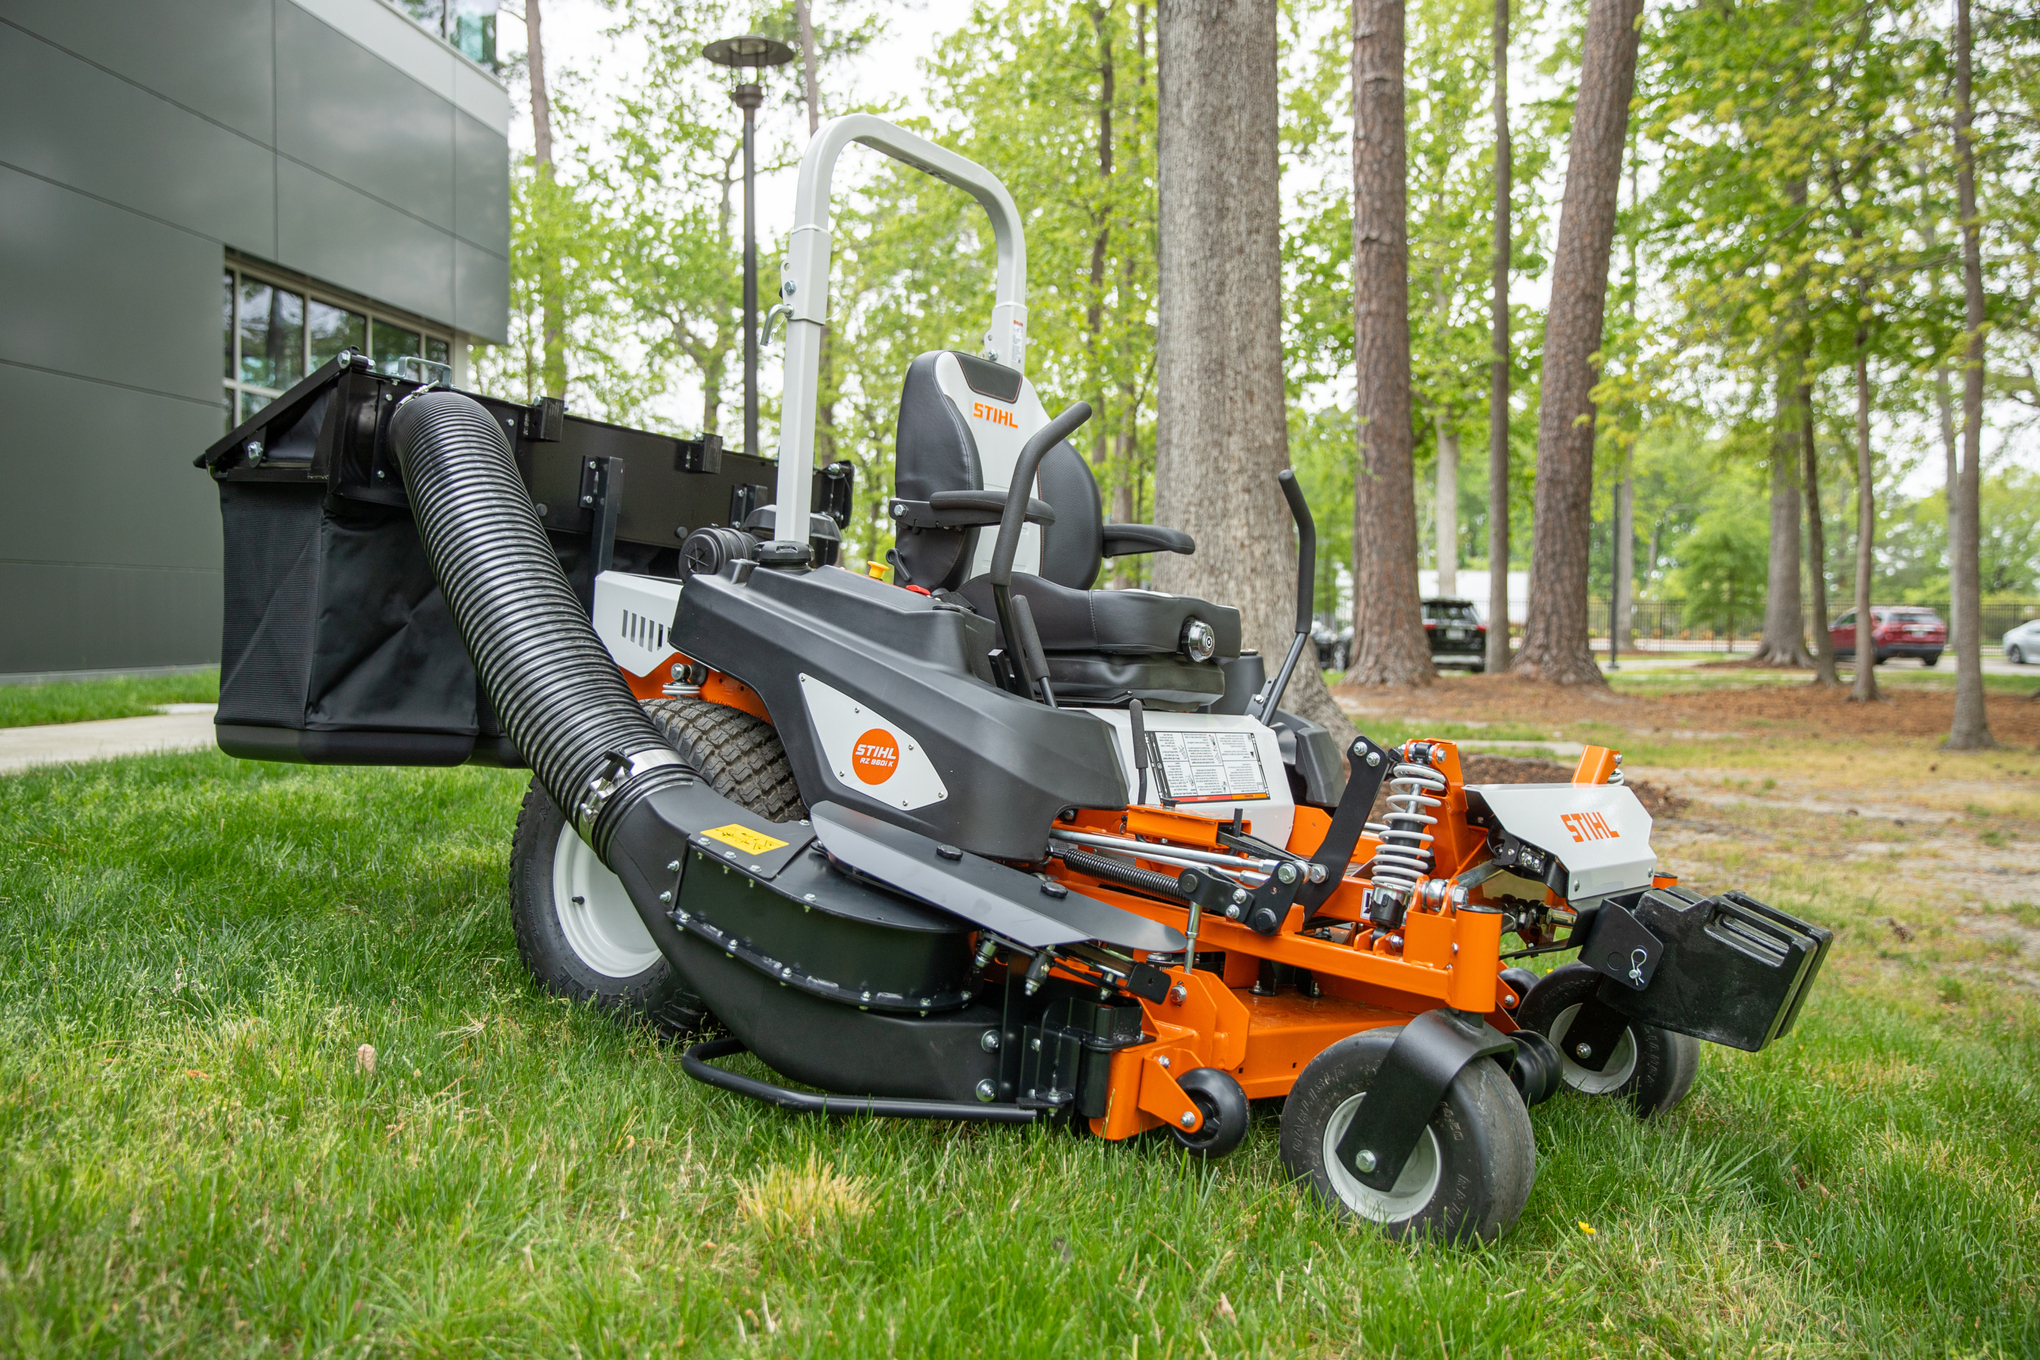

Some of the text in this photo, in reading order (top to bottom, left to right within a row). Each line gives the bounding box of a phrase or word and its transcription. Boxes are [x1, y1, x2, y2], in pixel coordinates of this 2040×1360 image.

[973, 402, 1019, 429] STIHL
[855, 743, 897, 760] STIHL
[859, 757, 870, 765] RZ
[1560, 811, 1620, 843] STIHL
